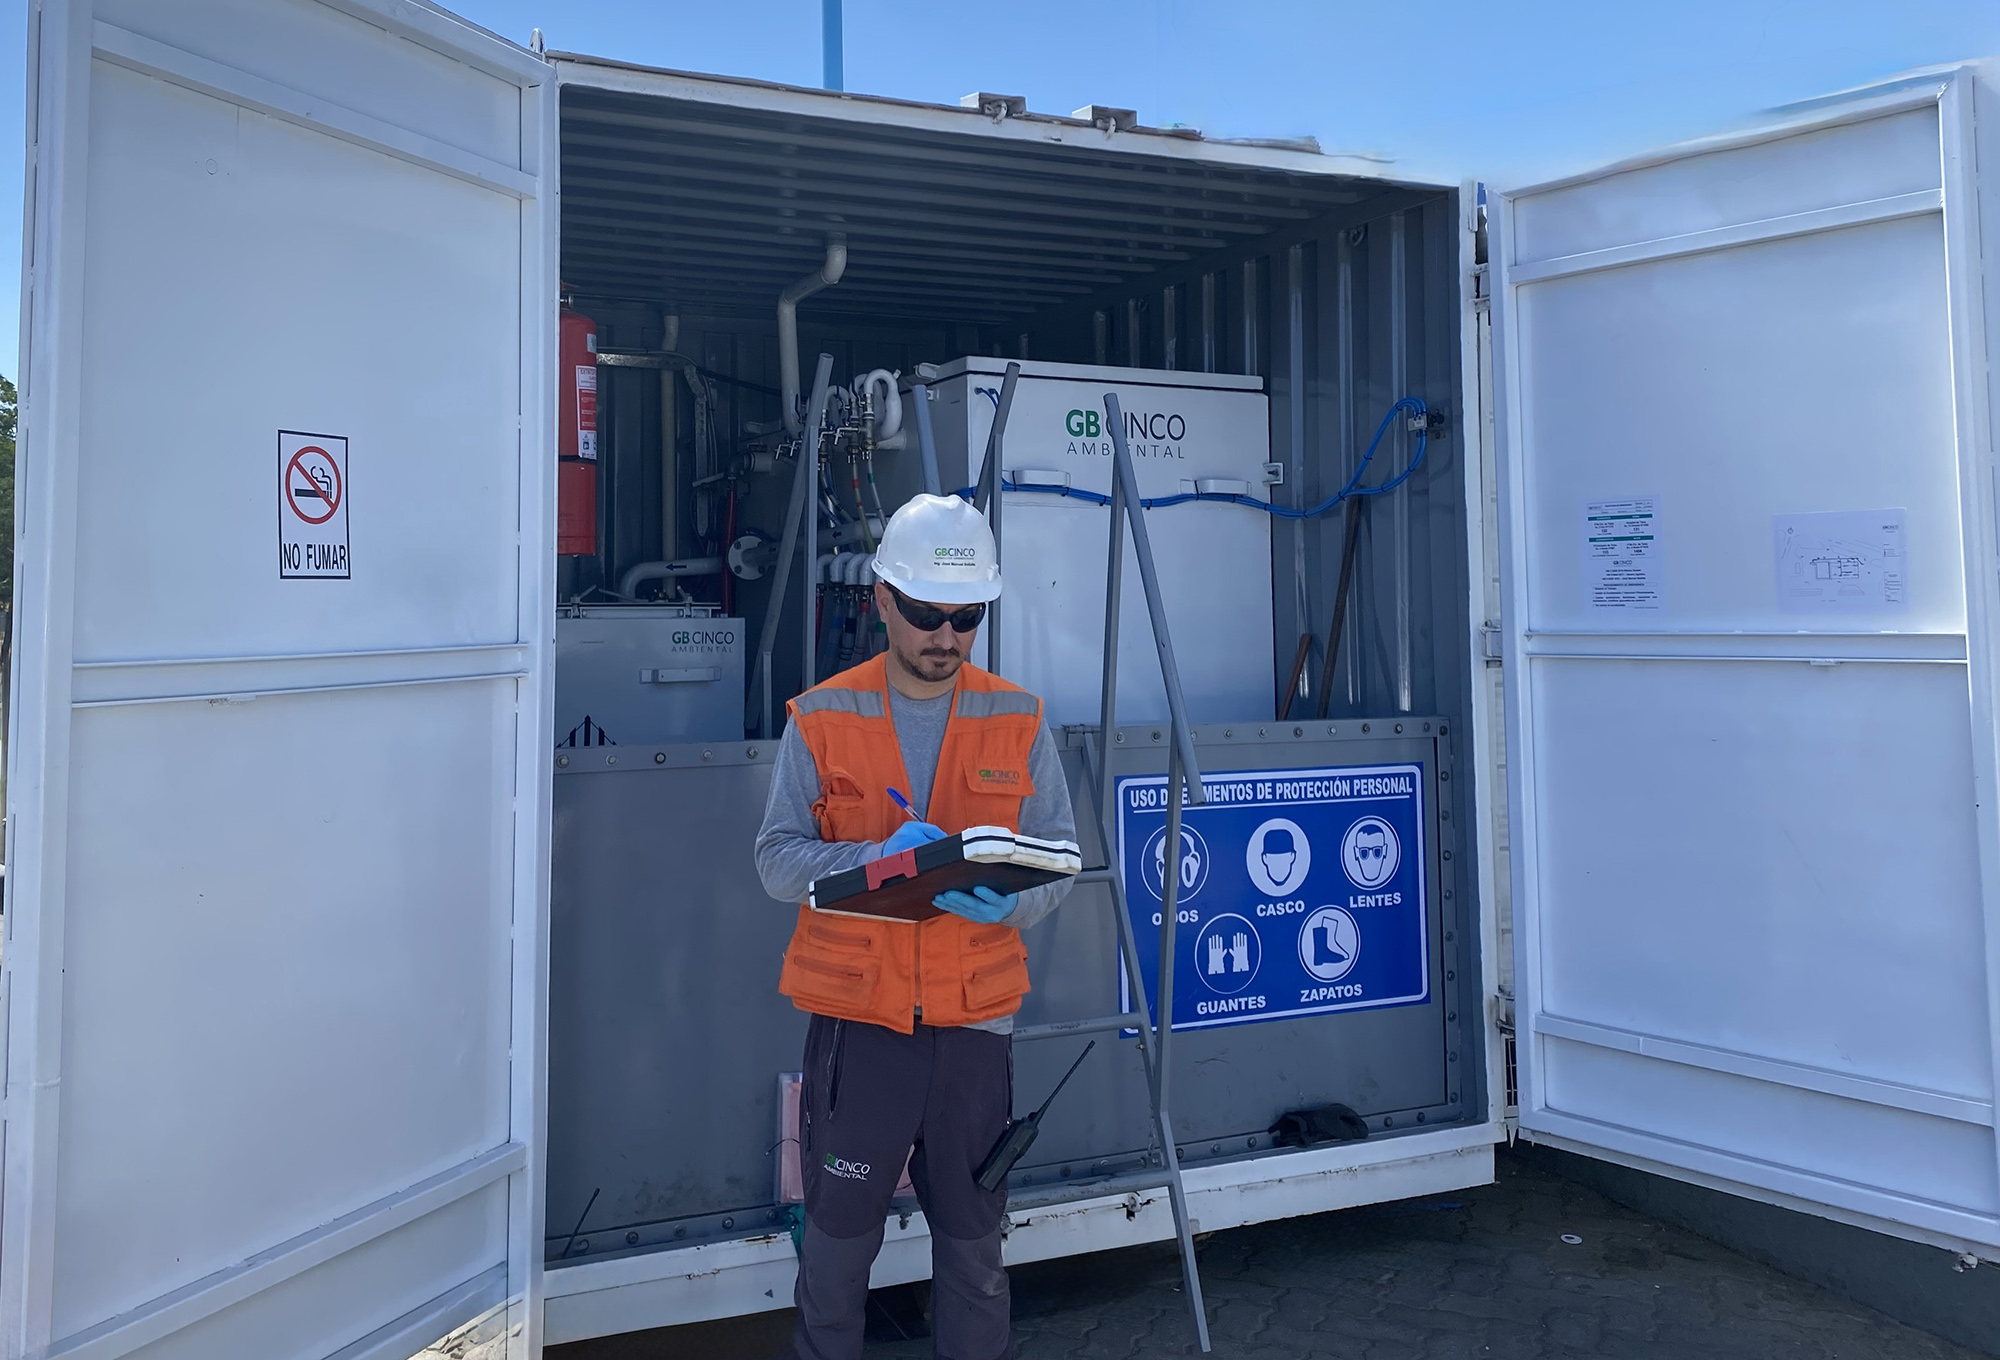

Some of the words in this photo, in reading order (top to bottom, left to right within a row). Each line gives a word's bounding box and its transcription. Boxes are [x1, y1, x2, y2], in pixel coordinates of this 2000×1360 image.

[1066, 441, 1186, 459] AMBNTAL
[283, 543, 301, 570] NO
[306, 543, 347, 570] FUMAR
[671, 645, 733, 653] AMBIENTAL
[1130, 788, 1157, 807] USO
[1181, 782, 1254, 805] EMENTOS
[1256, 782, 1273, 800] DE
[1275, 777, 1350, 800] PROTECCIÓN
[1353, 777, 1413, 796] PERSONAL
[1256, 900, 1305, 917] CASCO
[1349, 892, 1402, 908] LENTES
[1151, 909, 1199, 926] OOS
[1300, 984, 1363, 1002] ZAPATOS
[1196, 995, 1266, 1015] GUANTES
